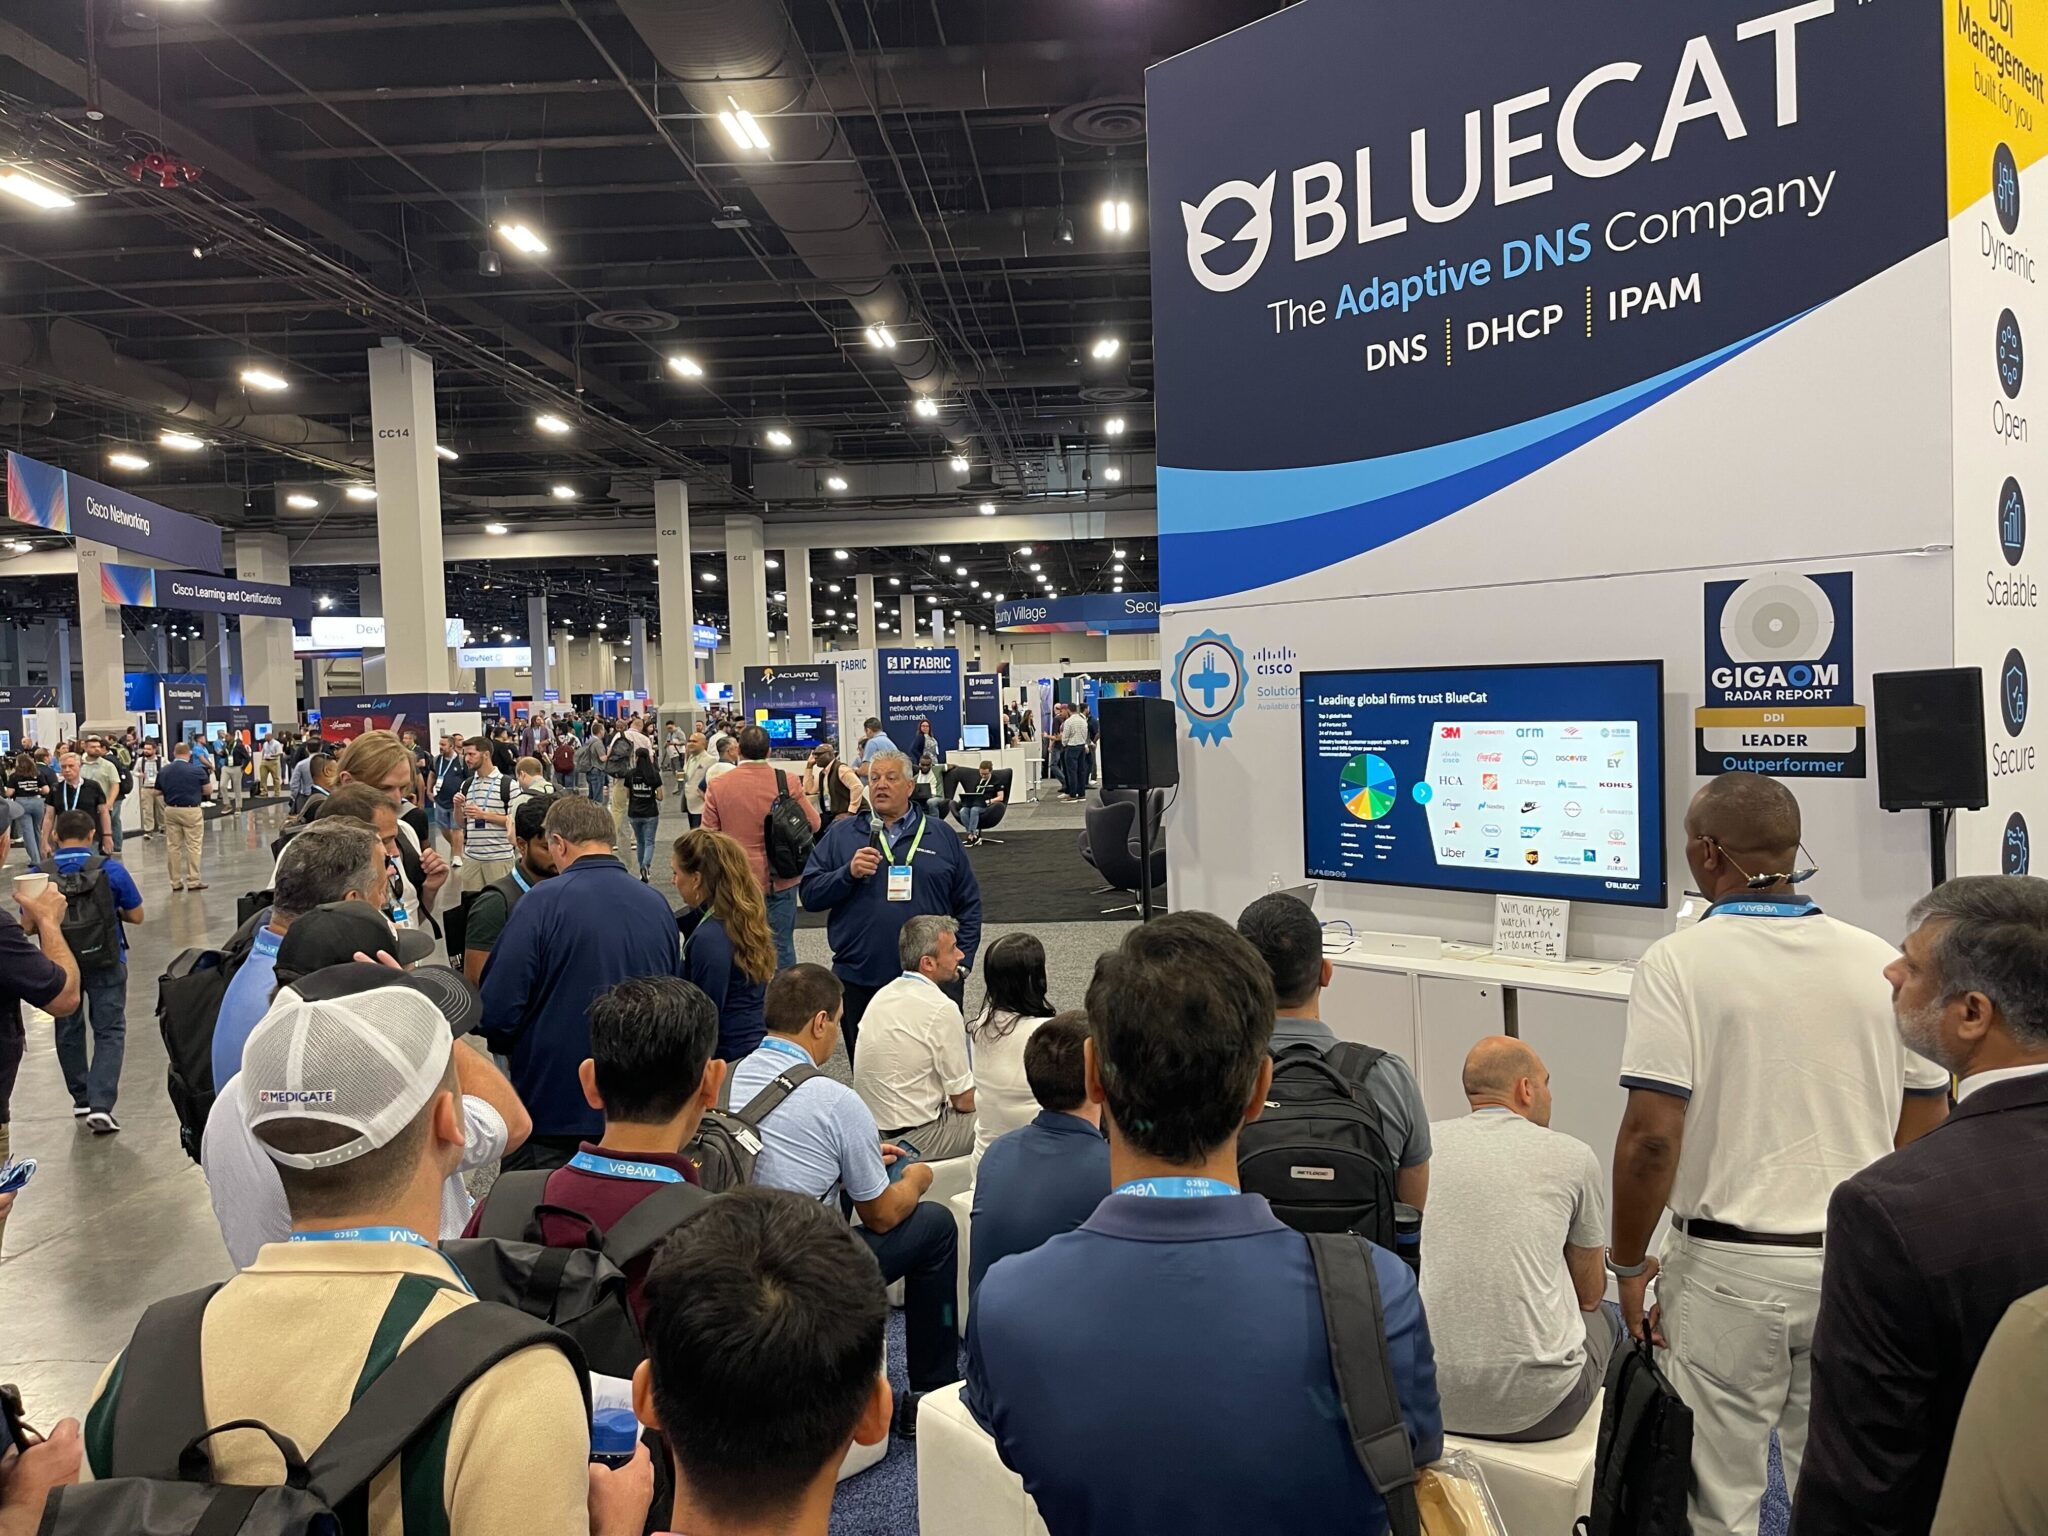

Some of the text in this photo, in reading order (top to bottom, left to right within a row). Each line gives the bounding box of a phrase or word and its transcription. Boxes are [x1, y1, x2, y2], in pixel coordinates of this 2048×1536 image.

[1958, 0, 2044, 104] Management
[1973, 62, 2032, 132] built for you
[1294, 0, 1834, 262] BLUECAT
[1268, 170, 1836, 335] The Adaptive DNS Company
[1981, 221, 2035, 284] Dynamic
[1365, 274, 1702, 372] DNS DHCP IPAM
[1993, 400, 2028, 446] Open
[378, 429, 410, 439] CC14
[86, 496, 150, 536] Cisco Networking
[172, 582, 282, 605] Cisco Learning and Certifications
[1987, 571, 2037, 607] Scalable
[1125, 599, 1160, 614] Secu
[1013, 606, 1047, 622] Village
[356, 623, 385, 634] DevN
[464, 654, 493, 662] DevNet
[841, 658, 867, 671] FABRIC
[901, 656, 952, 669] IP FABRIC
[1711, 664, 1839, 688] GIGAOM
[923, 695, 952, 703] enterprise
[1319, 691, 1487, 707] Leading global firms trust BlueCat
[1725, 689, 1832, 701] RADAR REPORT
[914, 703, 939, 713] visibility
[1257, 702, 1289, 710] Available
[889, 713, 908, 721] within
[1763, 713, 1784, 722] DDI
[1441, 727, 1461, 739] 3M
[1516, 727, 1544, 738] arm
[1742, 734, 1808, 747] LEADER
[1607, 759, 1621, 768] EY
[1722, 757, 1844, 774] Outperformer
[1992, 743, 2035, 778] Secure
[1439, 775, 1463, 786] HCA
[1440, 847, 1465, 858] Uber
[1612, 881, 1640, 890] BLUECAT
[1501, 901, 1560, 919] Win an Apple
[270, 1091, 333, 1103] MEDIGATE
